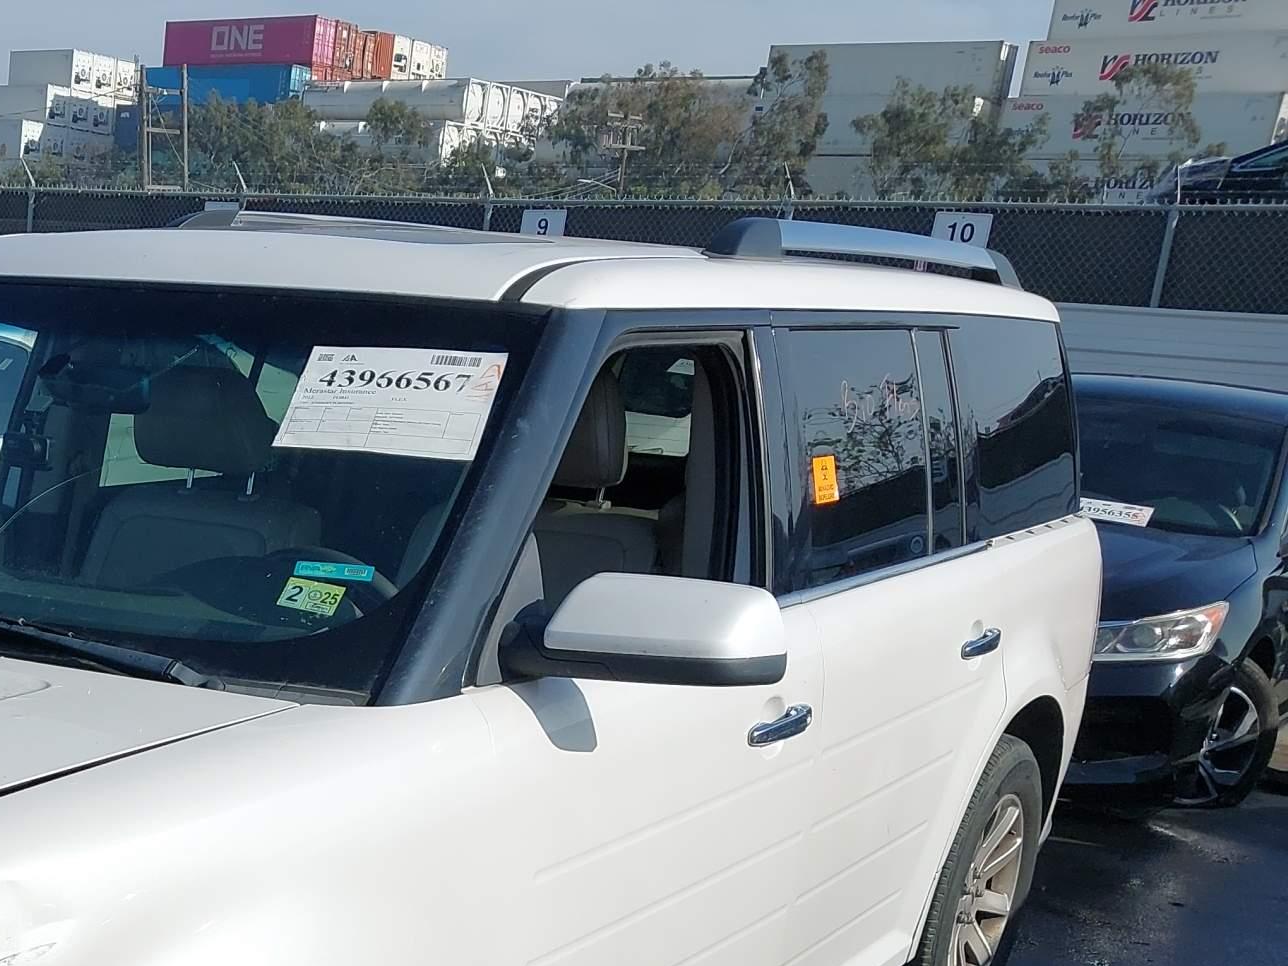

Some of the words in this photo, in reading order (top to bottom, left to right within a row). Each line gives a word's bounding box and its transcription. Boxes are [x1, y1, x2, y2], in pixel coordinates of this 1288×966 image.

[211, 24, 265, 51] ONE
[1039, 45, 1072, 54] seaco
[1134, 51, 1220, 66] HORIZON
[1011, 101, 1044, 111] seaco
[537, 218, 549, 236] 9
[947, 222, 975, 243] 10
[319, 369, 473, 393] 43966567
[285, 585, 304, 603] 2
[319, 591, 341, 606] 25
